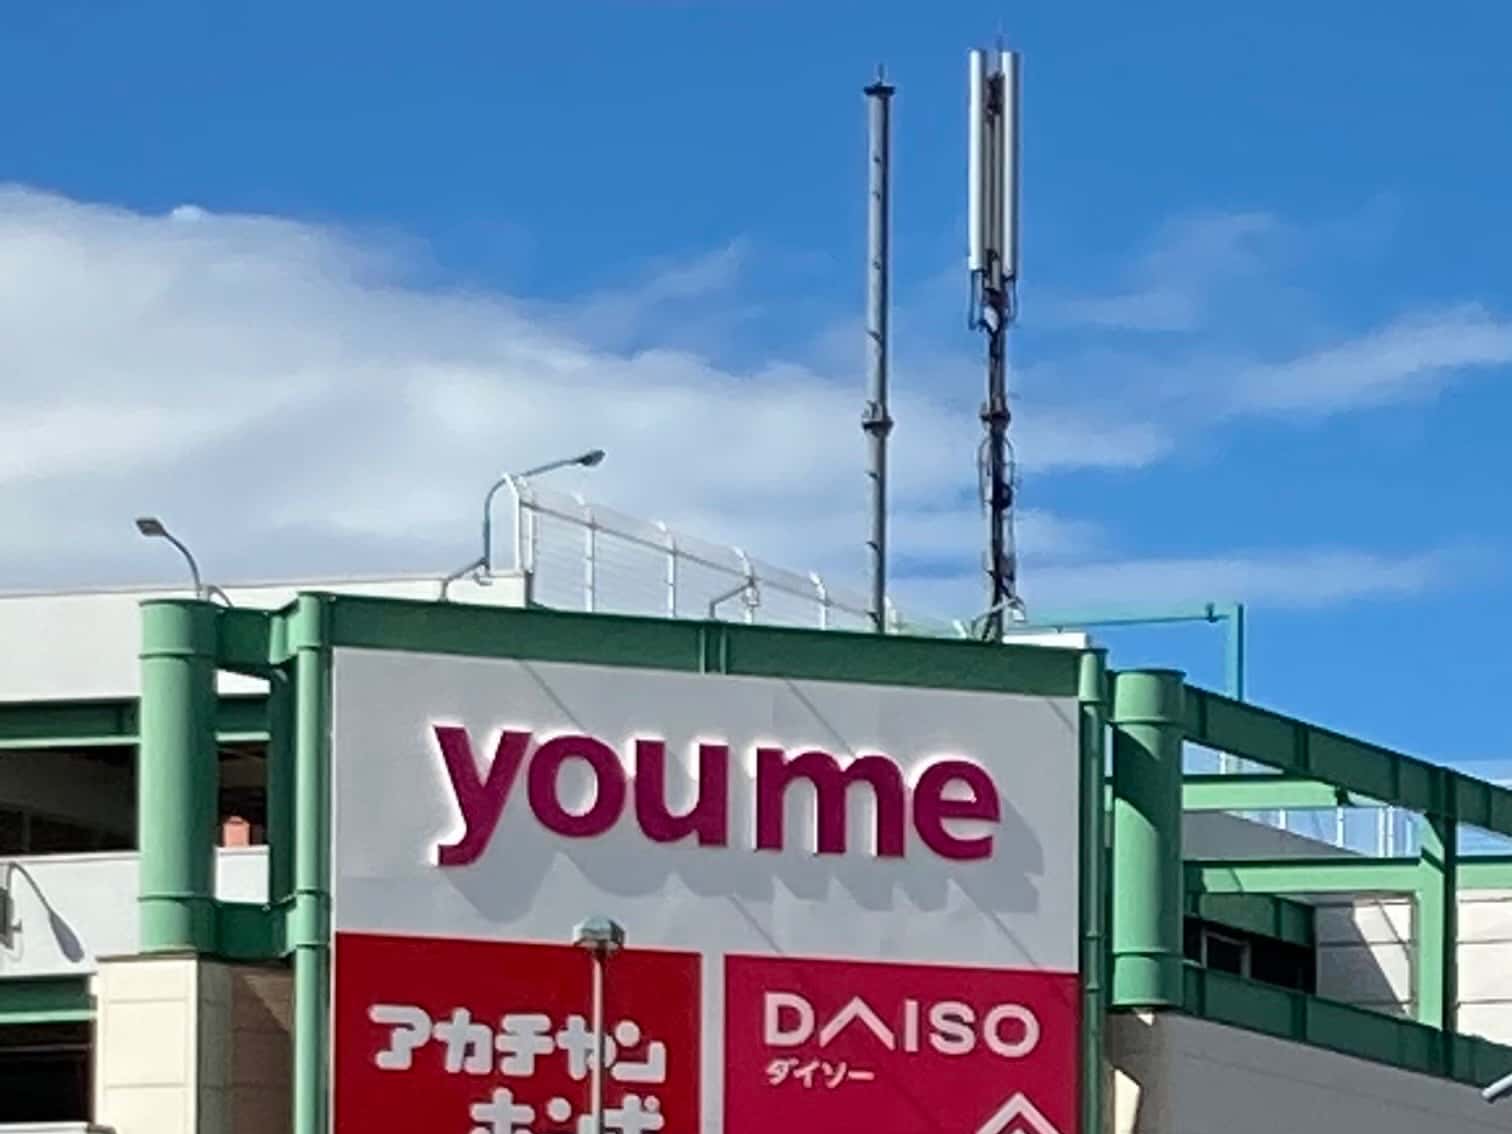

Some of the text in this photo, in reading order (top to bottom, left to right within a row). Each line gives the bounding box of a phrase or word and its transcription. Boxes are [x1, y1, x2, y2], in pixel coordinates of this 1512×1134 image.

[763, 991, 1041, 1058] DAISO
[765, 1057, 875, 1089] ダイソー
